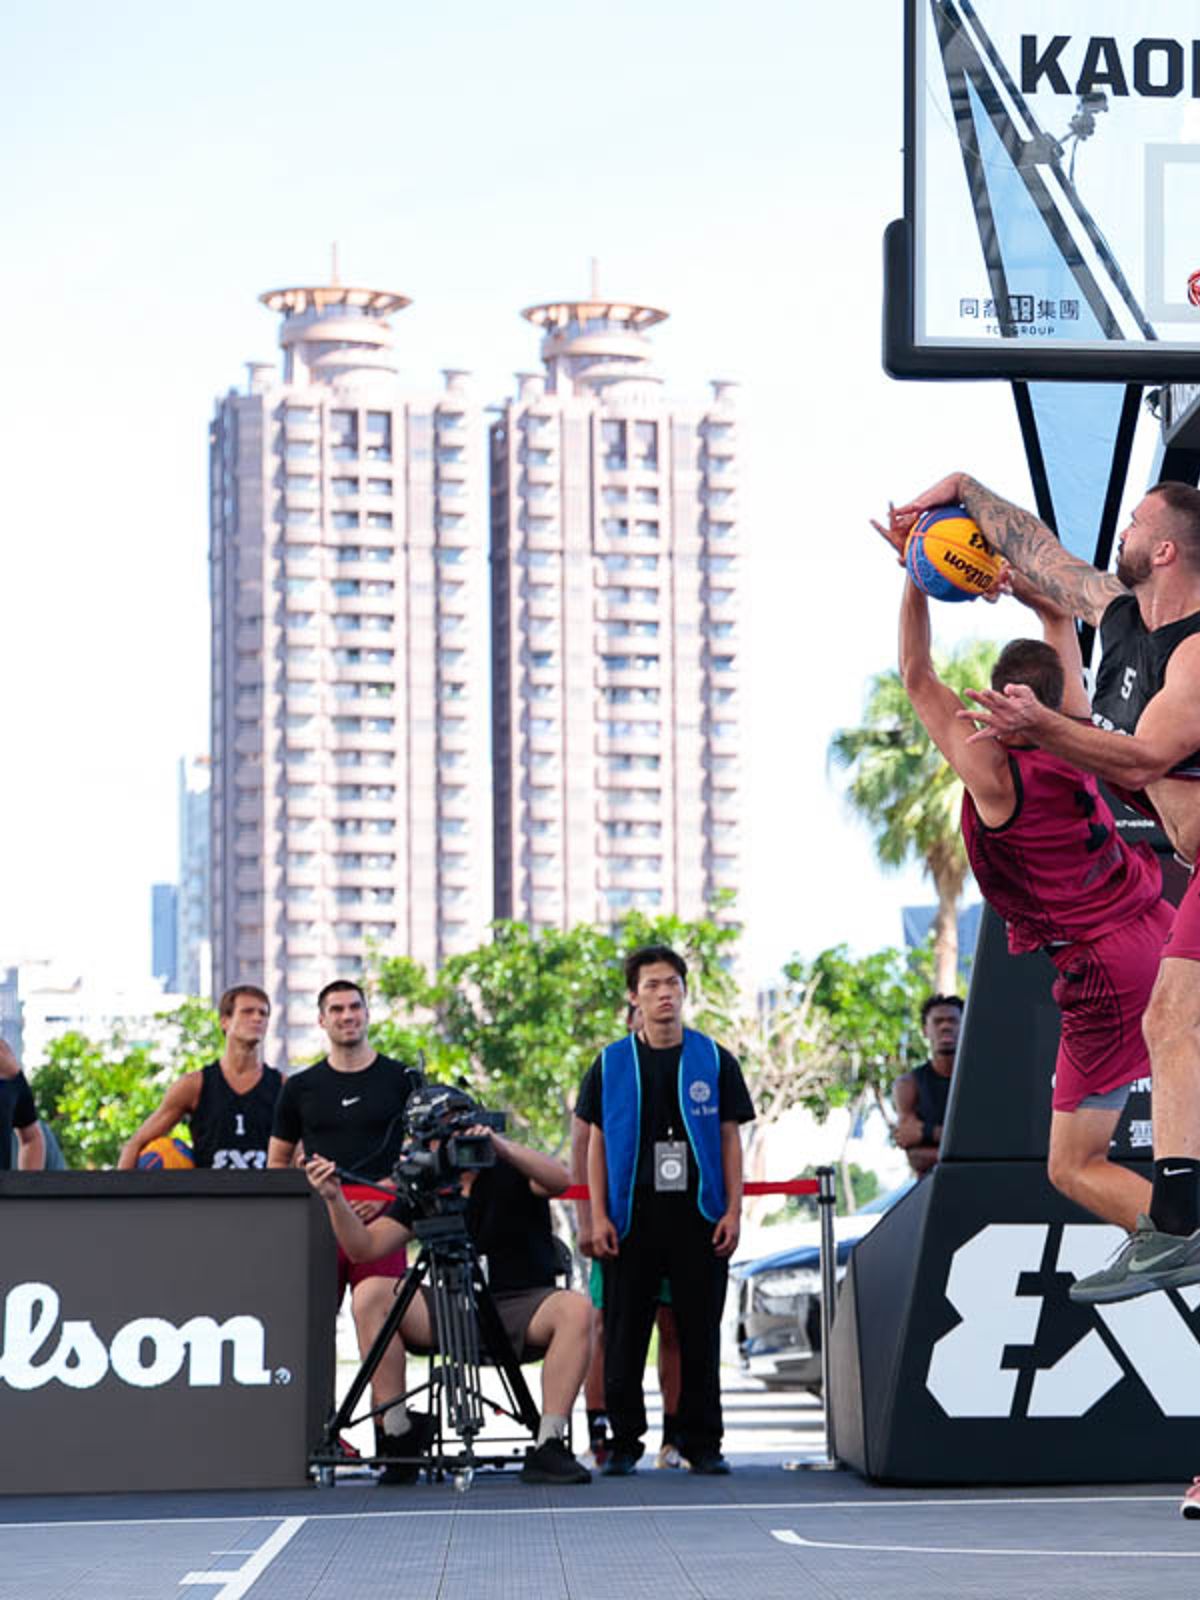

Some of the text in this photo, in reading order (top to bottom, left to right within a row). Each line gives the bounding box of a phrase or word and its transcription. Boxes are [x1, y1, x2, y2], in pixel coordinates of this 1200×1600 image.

[1121, 667, 1137, 700] 5
[235, 1114, 246, 1136] 1
[0, 1282, 272, 1390] lson
